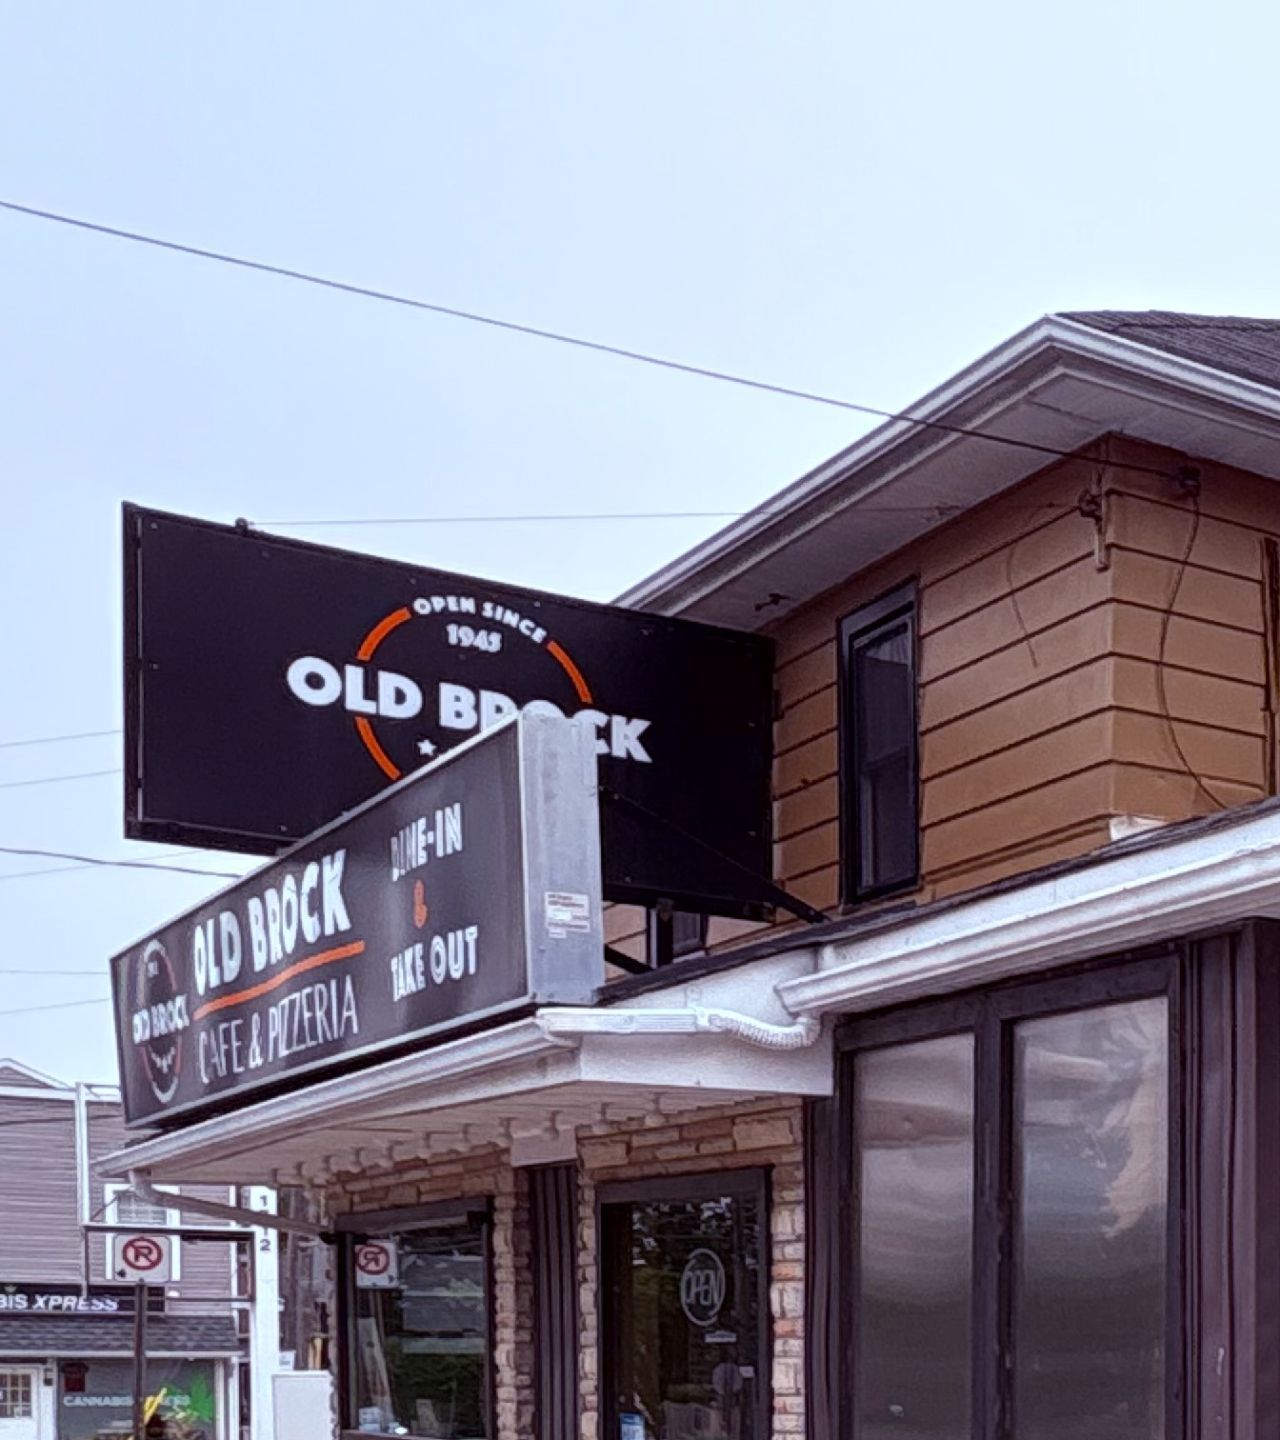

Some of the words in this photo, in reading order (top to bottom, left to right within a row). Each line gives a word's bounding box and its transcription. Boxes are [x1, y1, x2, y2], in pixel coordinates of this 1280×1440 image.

[413, 595, 476, 616] OPEN
[482, 602, 548, 644] SINCE
[446, 623, 502, 653] 1945
[286, 656, 423, 720] OLD
[438, 682, 652, 763] BRK
[390, 803, 463, 882] DINE-IN
[193, 910, 242, 996] OLD
[247, 848, 352, 973] BROCK
[390, 942, 427, 1003] TAKE
[430, 924, 479, 985] OUT
[199, 1018, 246, 1085] CAFE
[248, 1011, 263, 1069] &
[267, 973, 359, 1063] PIZZERIA
[32, 1294, 119, 1312] XPRESS
